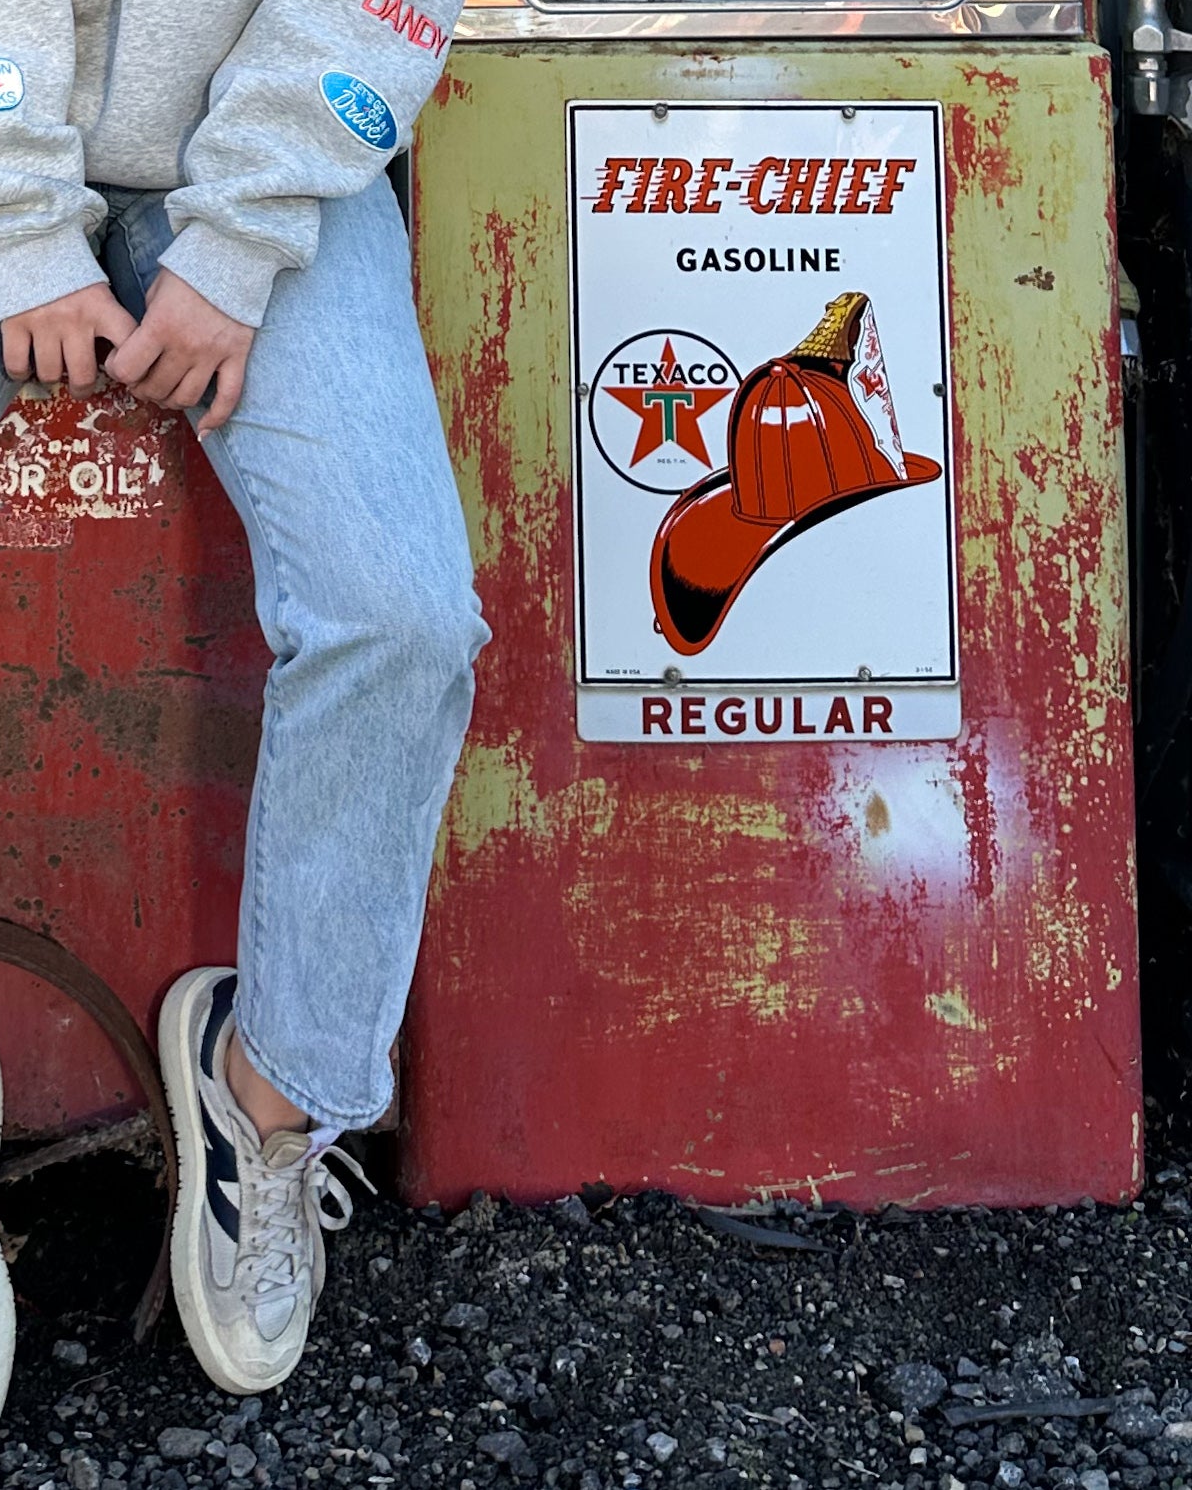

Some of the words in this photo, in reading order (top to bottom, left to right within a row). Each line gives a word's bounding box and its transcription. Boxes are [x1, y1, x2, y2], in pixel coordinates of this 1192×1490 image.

[590, 157, 916, 214] FIRE-CHIEF
[676, 247, 841, 273] GASOLINE
[613, 363, 729, 386] TEXACO
[69, 461, 144, 497] OIL
[642, 696, 893, 736] REGULAR
